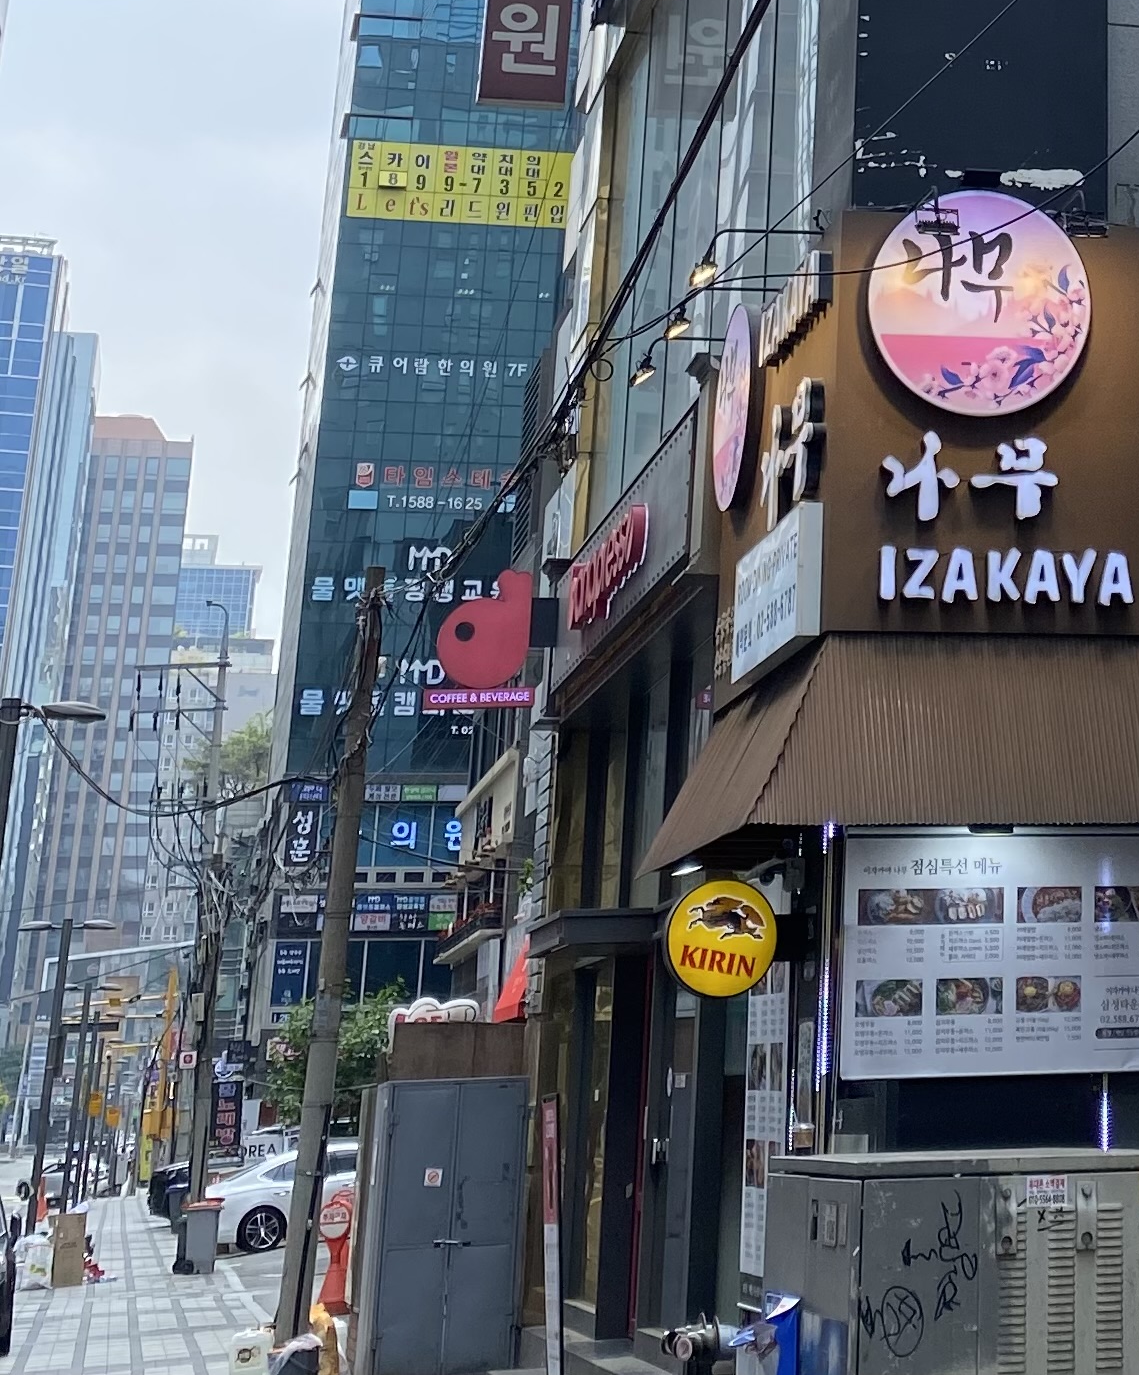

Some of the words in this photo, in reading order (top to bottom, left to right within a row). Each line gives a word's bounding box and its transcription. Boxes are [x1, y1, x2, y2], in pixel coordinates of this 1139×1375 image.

[358, 151, 430, 169] 스카이
[507, 363, 528, 377] 7F
[881, 431, 1060, 523] 나무
[878, 546, 1135, 606] IZAKAYA
[430, 693, 468, 704] COFFEE
[470, 693, 478, 703] &
[480, 691, 530, 702] BEVERAGE
[289, 810, 314, 863] 성훈
[910, 858, 968, 876] 점심특선
[974, 857, 1002, 875] 메뉴
[679, 945, 757, 979] KIRIN
